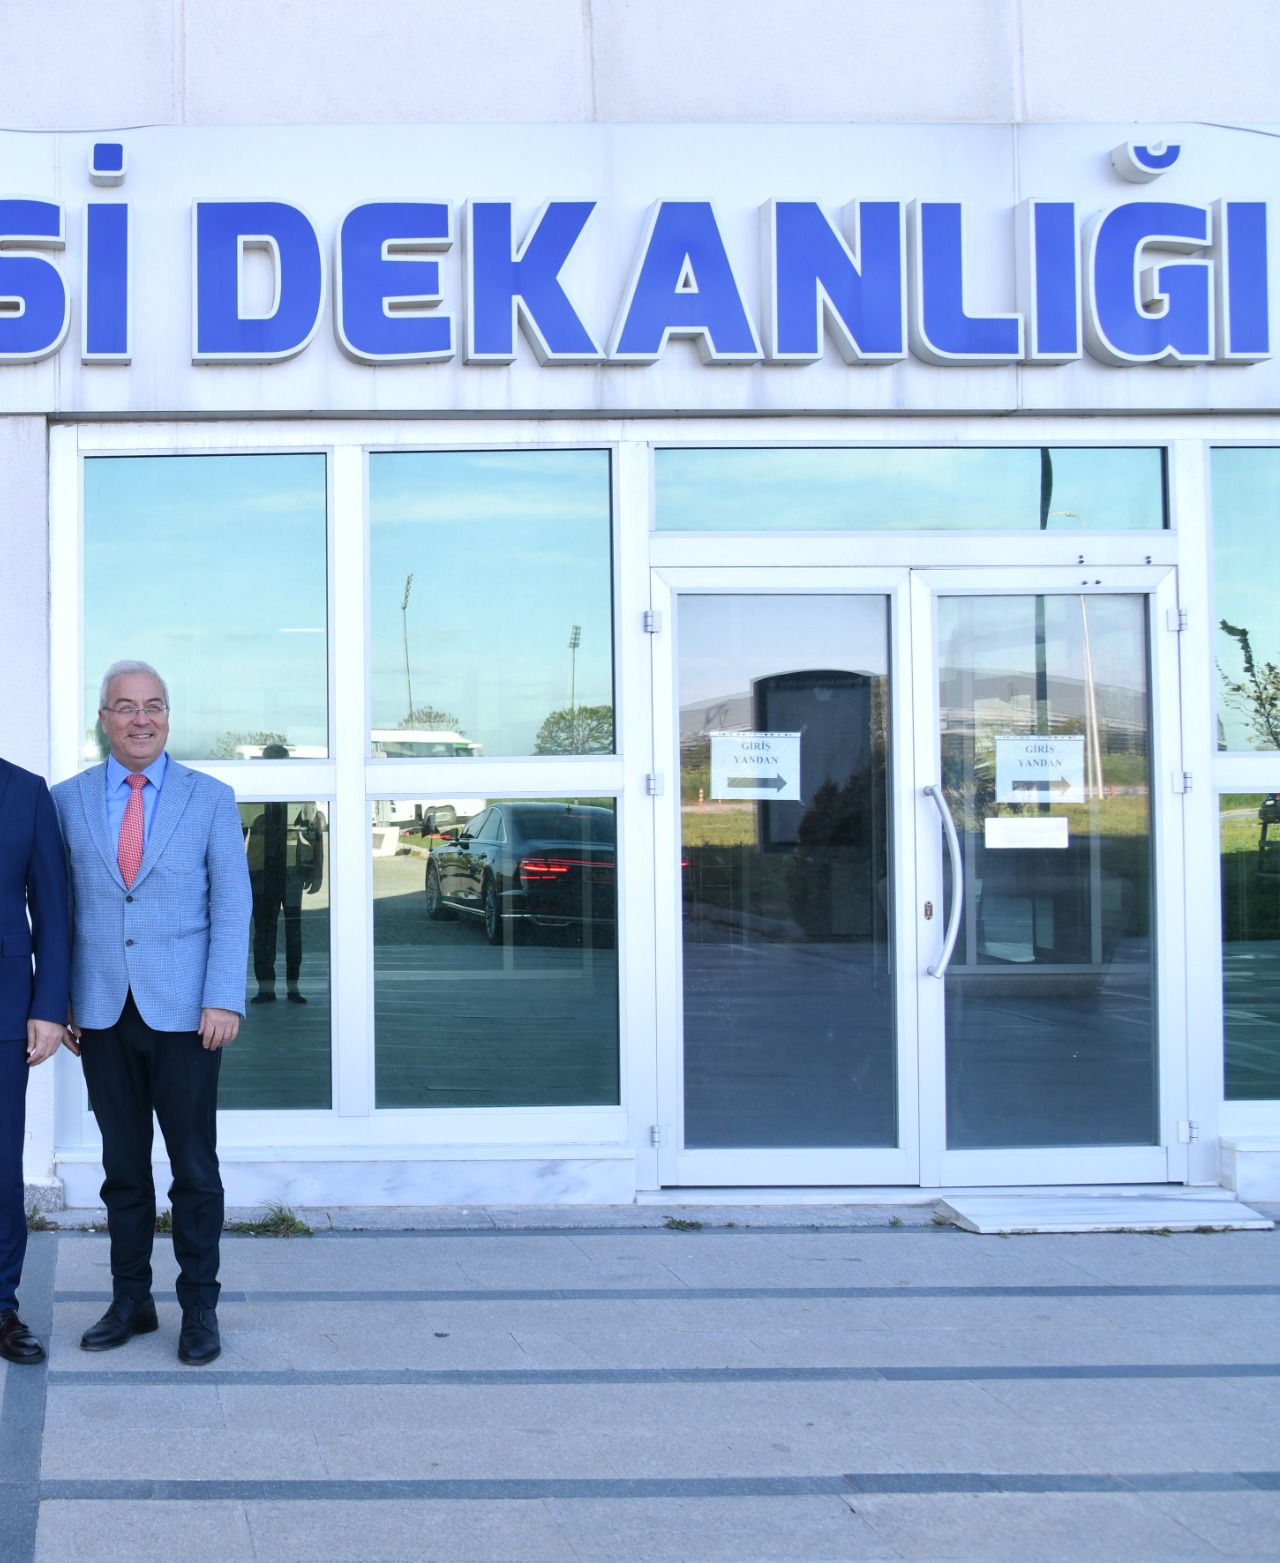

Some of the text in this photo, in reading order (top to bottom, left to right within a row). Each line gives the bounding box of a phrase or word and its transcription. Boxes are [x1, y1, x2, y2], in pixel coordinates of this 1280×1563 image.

[191, 144, 1274, 364] DEKANLIĞI
[741, 740, 772, 752] GİRİŞ
[1025, 743, 1055, 755] GİRİŞ
[733, 755, 779, 764] YANDAN
[1018, 758, 1062, 768] YANDAN
